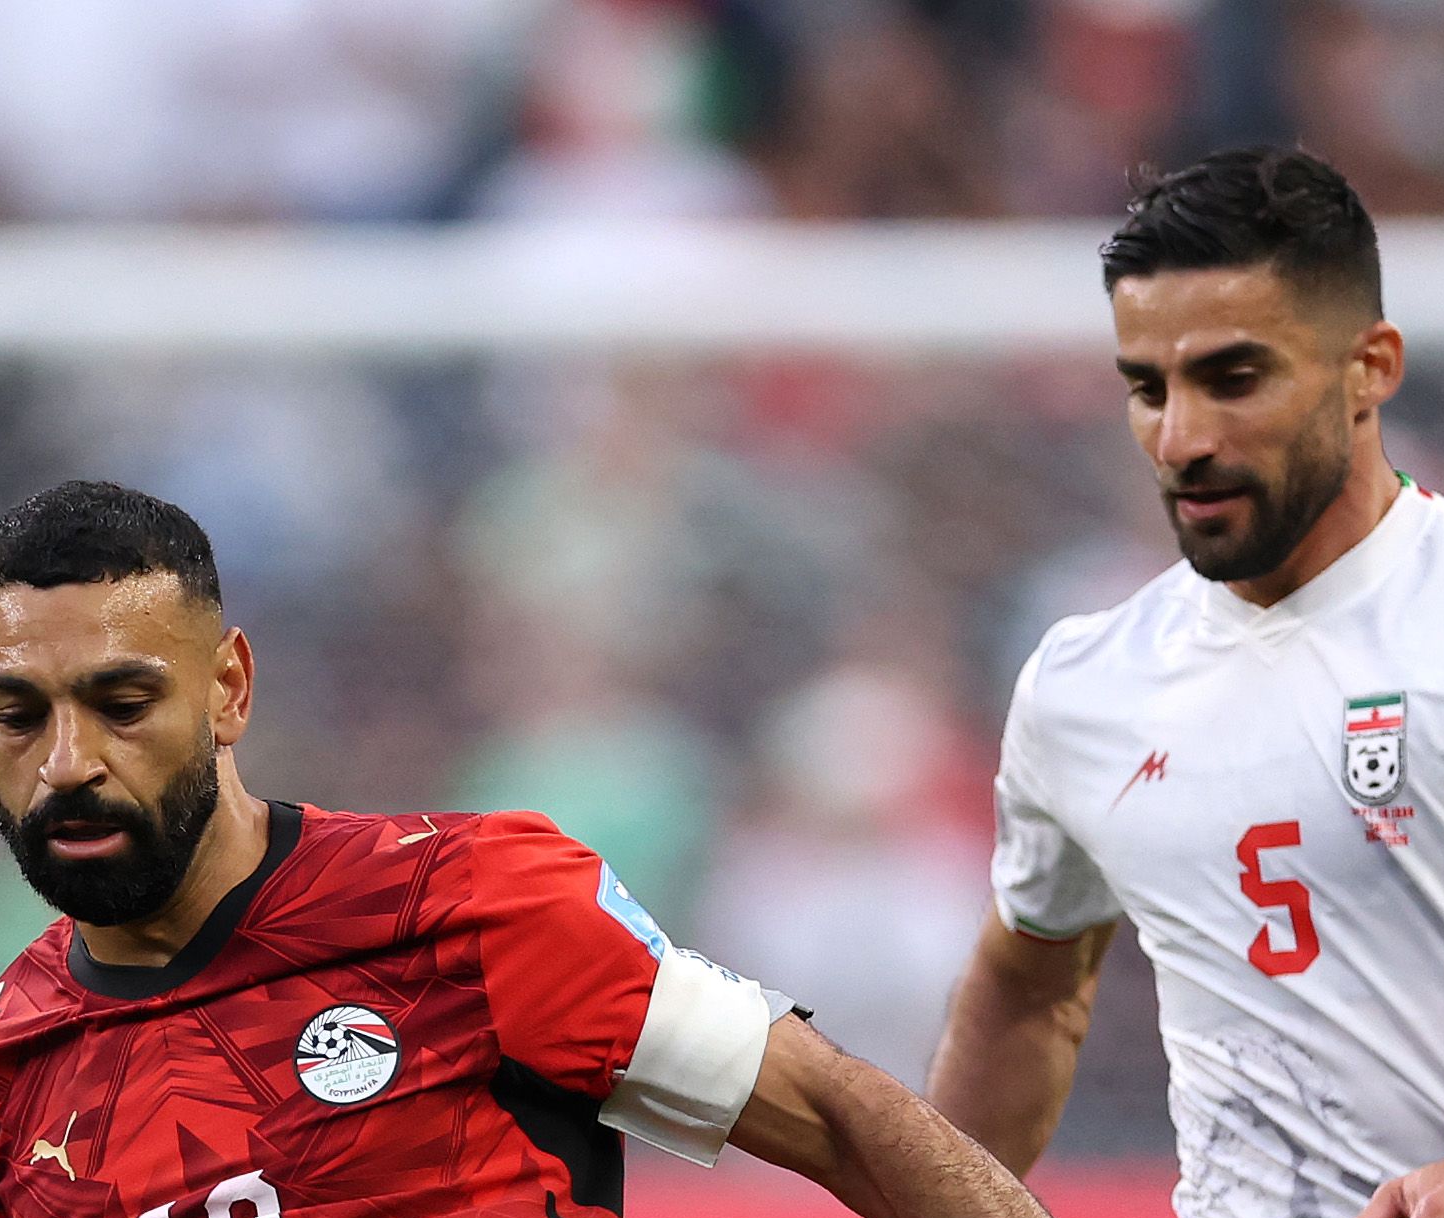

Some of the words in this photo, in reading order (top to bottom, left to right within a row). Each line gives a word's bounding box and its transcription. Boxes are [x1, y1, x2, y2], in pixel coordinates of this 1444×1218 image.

[1235, 820, 1320, 977] 5
[328, 1085, 368, 1097] EGYPTIAN
[368, 1078, 379, 1088] FA
